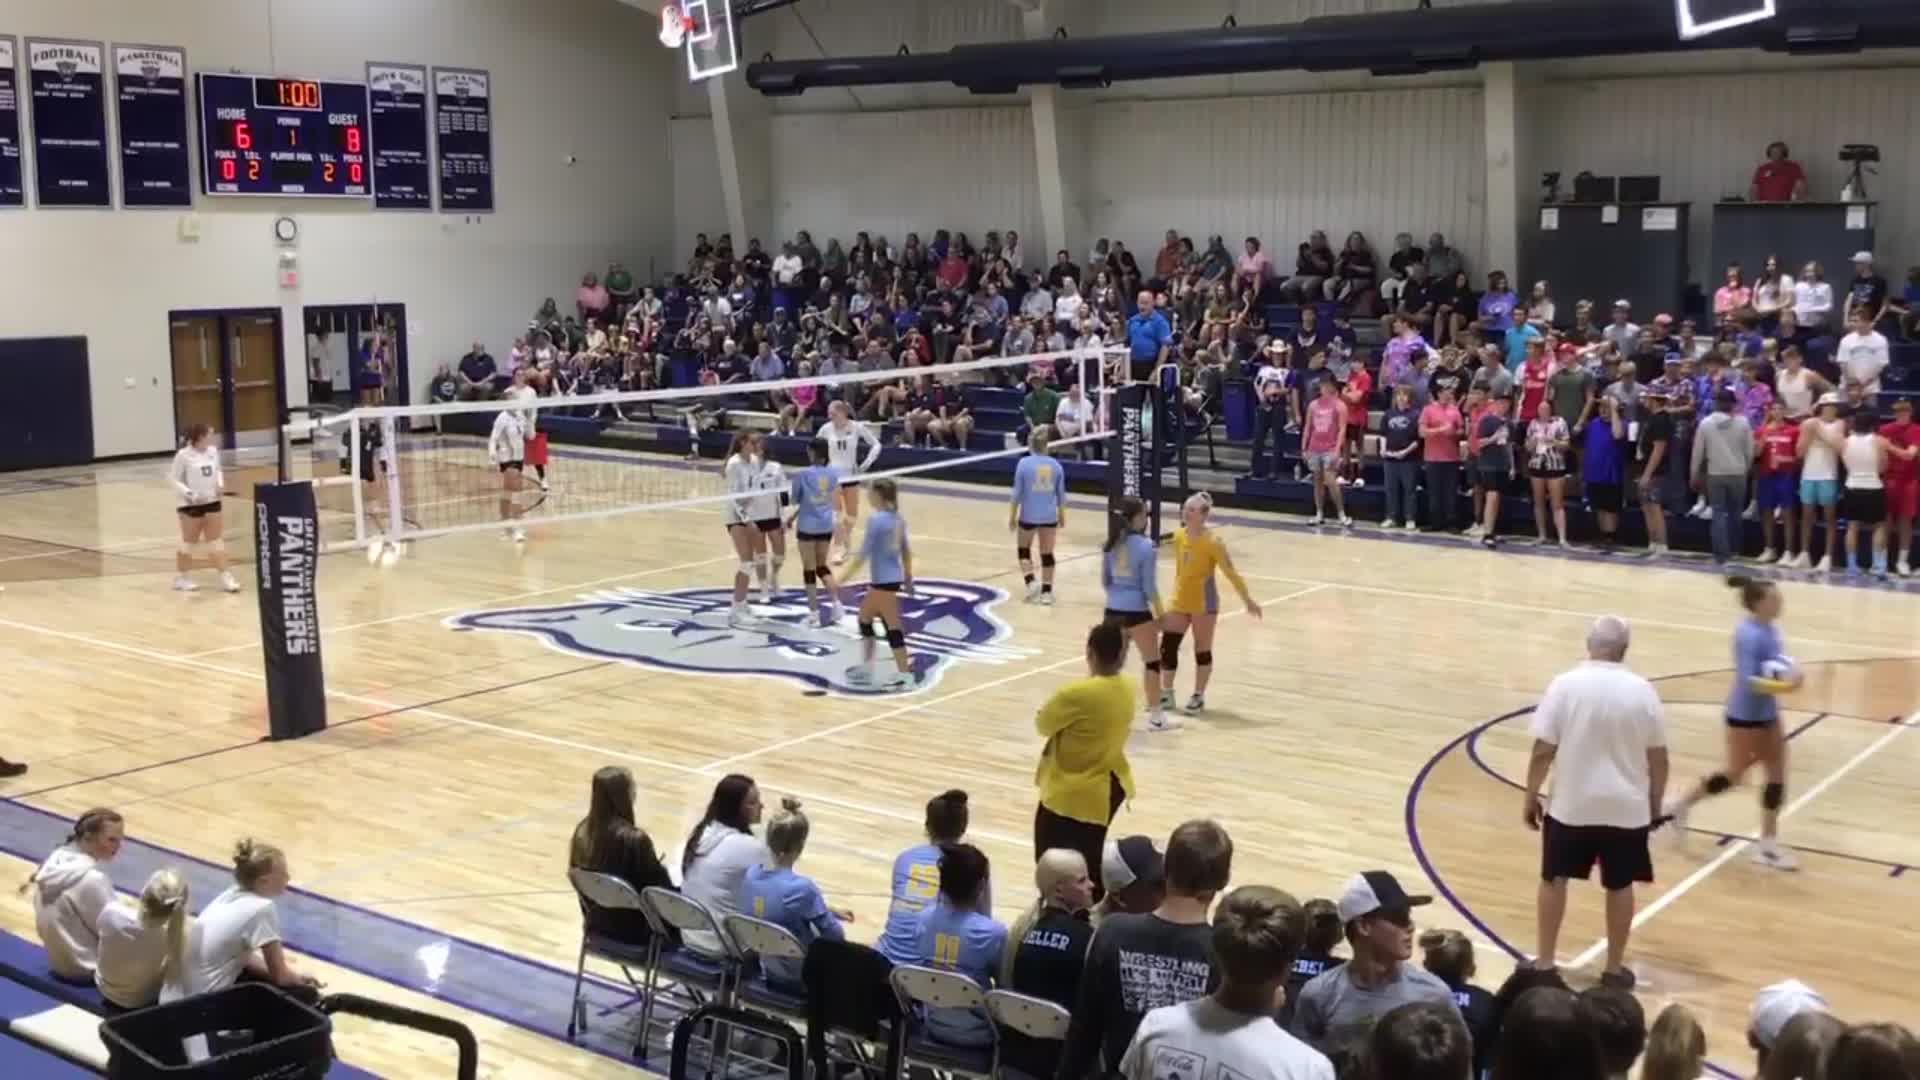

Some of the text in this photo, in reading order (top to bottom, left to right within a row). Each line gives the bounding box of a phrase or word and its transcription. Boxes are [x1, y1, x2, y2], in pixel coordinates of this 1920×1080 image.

[33, 47, 97, 66] FOOTBALL
[119, 50, 180, 67] BASKETBALL
[279, 82, 318, 107] 1:00
[216, 108, 247, 120] HOME
[328, 113, 358, 125] GUEST
[235, 123, 251, 149] 6
[347, 128, 360, 153] 8
[223, 160, 235, 180] 0
[248, 160, 260, 181] 2
[323, 162, 335, 182] 2
[350, 163, 362, 183] 0
[1122, 407, 1135, 496] PANTHERS
[277, 515, 308, 655] PANTHERS
[1119, 949, 1211, 976] WRESTLING
